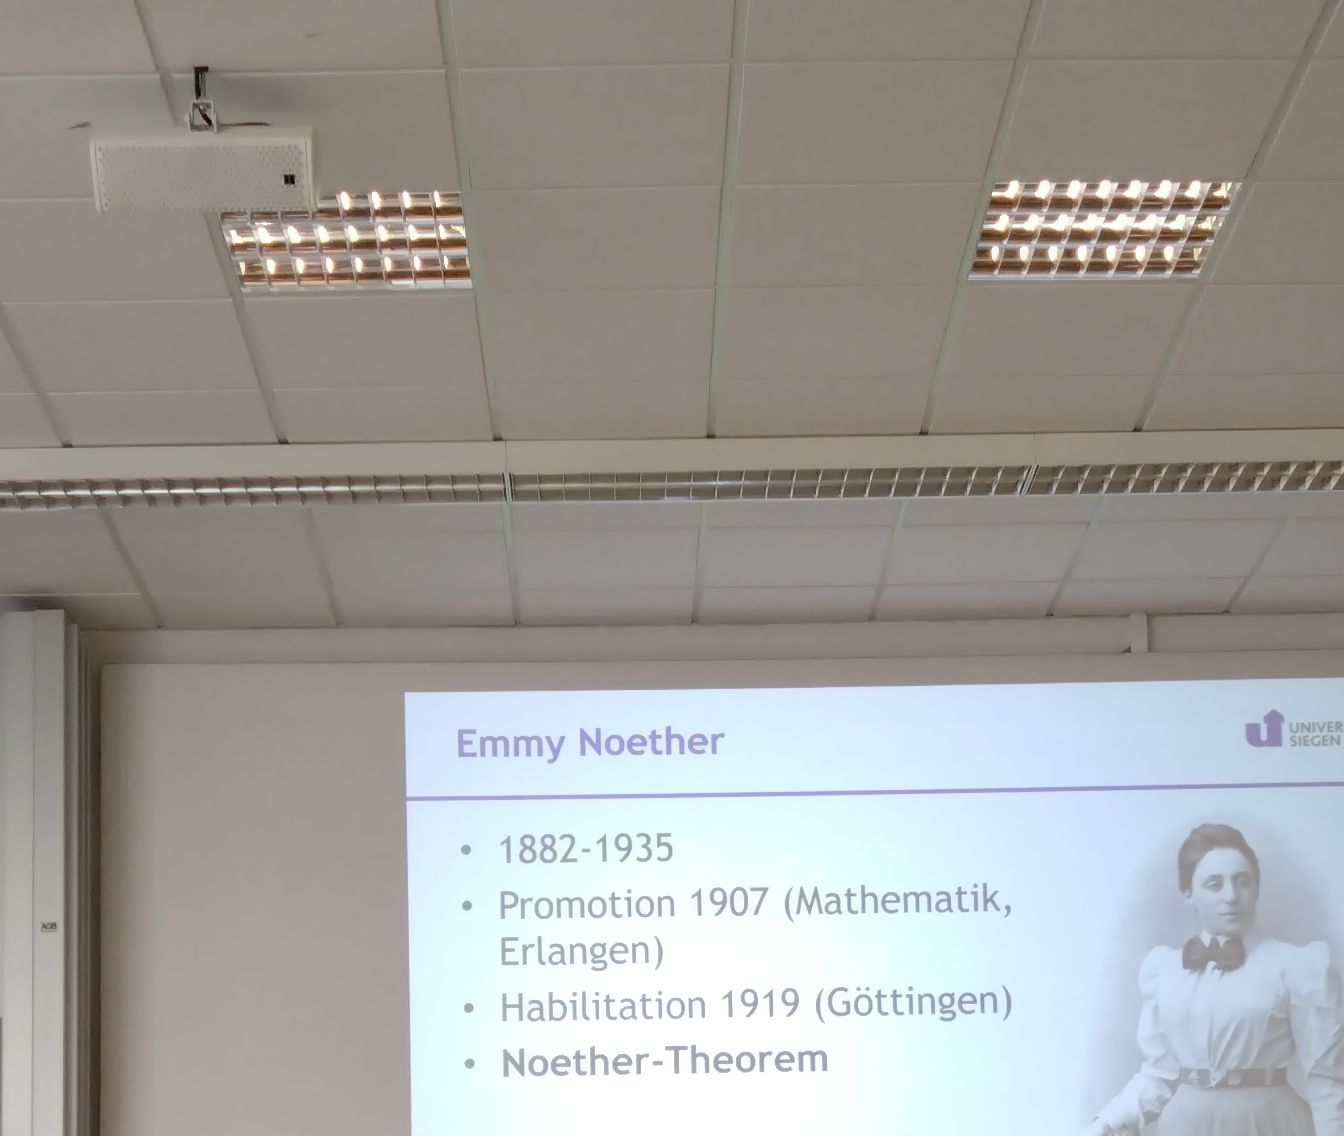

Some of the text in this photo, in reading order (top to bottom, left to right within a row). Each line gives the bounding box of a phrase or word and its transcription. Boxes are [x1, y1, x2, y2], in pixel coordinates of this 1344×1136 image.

[457, 725, 726, 764] Emmy Noether
[1289, 734, 1342, 747] SIEGEN
[499, 833, 675, 865] 1882-1935
[499, 882, 1013, 923] Promotion 1907 (Mathematik,
[500, 936, 665, 972] Erlangen)
[501, 985, 1014, 1025] Habilitation 1919 (Göttingen)
[502, 1044, 829, 1077] Noether-Theorem
